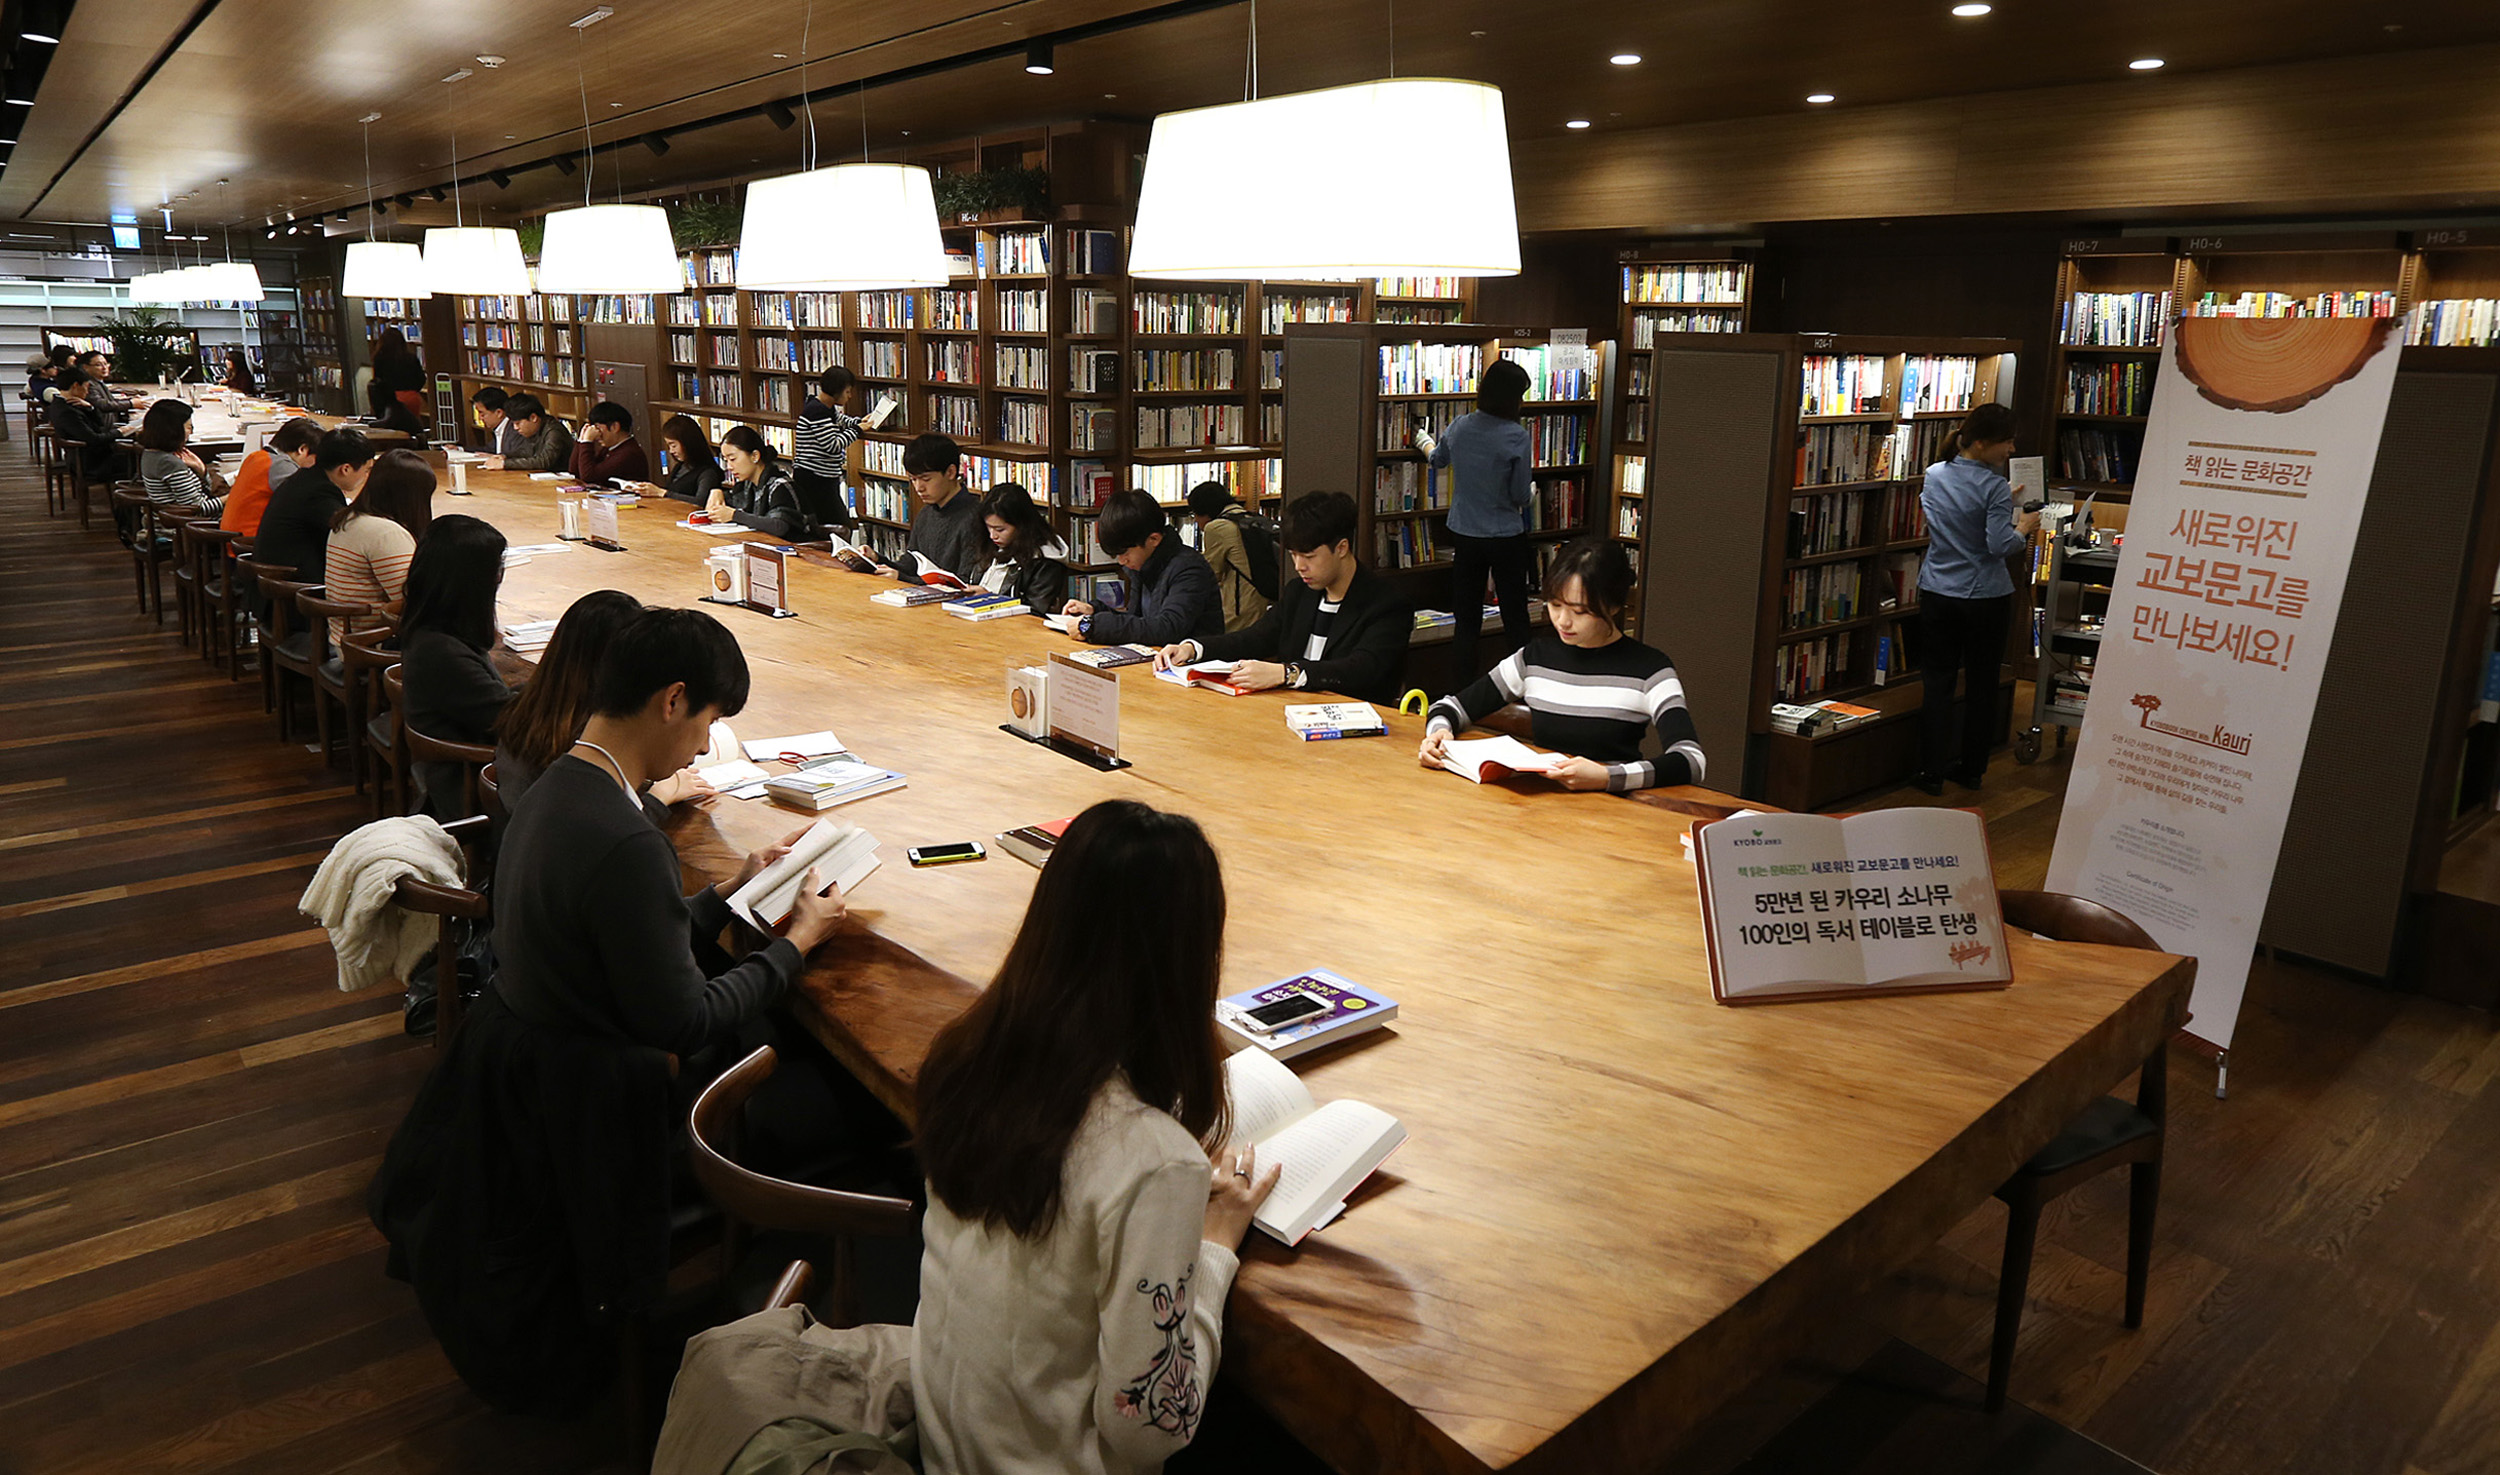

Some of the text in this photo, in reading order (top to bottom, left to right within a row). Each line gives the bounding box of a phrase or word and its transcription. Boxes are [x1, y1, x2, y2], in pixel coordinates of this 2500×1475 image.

[2185, 455, 2312, 486] 책 읽는 문화공간
[2170, 509, 2297, 560] 새로워진
[2137, 552, 2309, 619] 교보문고를
[2133, 605, 2294, 672] 만나보세요!
[2212, 724, 2252, 751] Kauri
[1734, 839, 1762, 847] KYOBO
[1811, 860, 1854, 874] 새로워진
[1858, 858, 1910, 872] 교보문고를
[1913, 855, 1959, 869] 만나세요!
[1755, 884, 1952, 914] 5만년 된 카우리 소나무
[1740, 913, 1977, 945] 100인의 독서 테이블로 탄생
